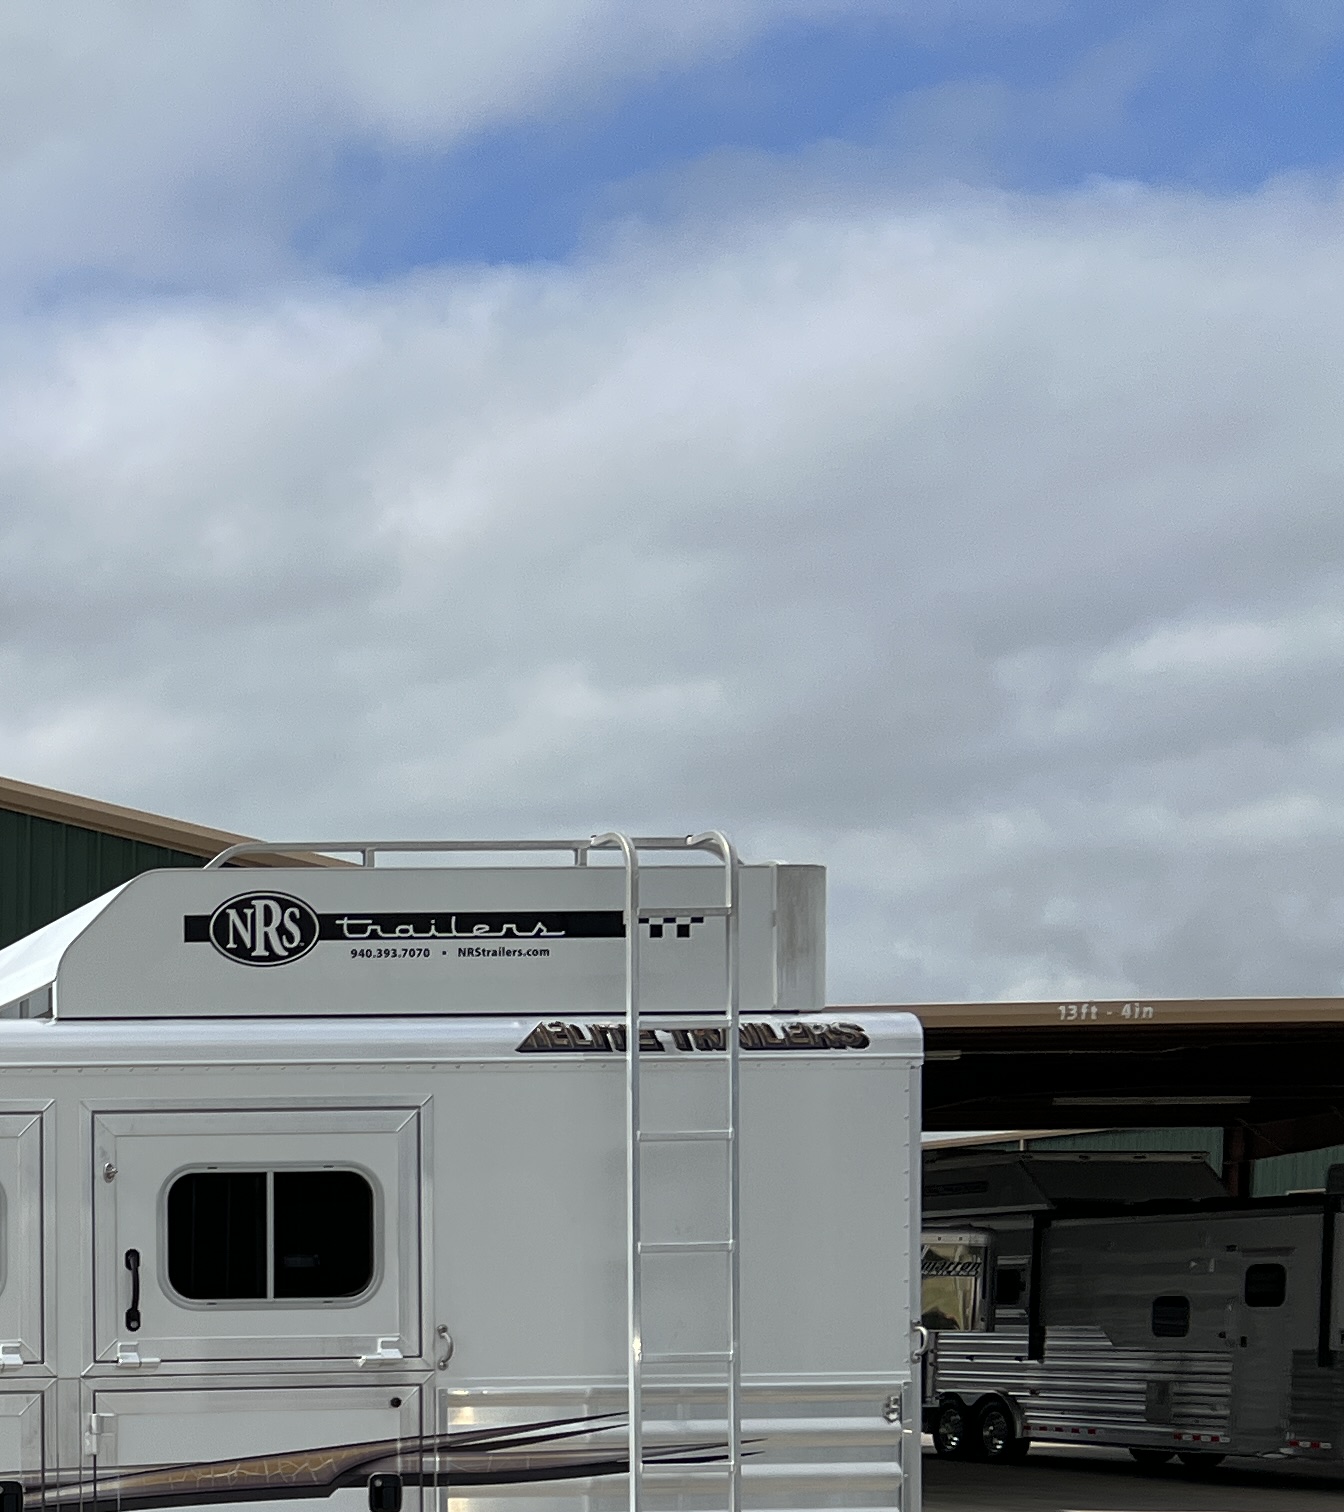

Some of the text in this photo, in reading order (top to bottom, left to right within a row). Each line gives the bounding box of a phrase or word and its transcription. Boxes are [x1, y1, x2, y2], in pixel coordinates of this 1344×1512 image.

[225, 899, 302, 957] NRS
[335, 916, 566, 938] trailers
[350, 947, 550, 959] 940.393.7070 NRStrailers.com
[1057, 1003, 1098, 1021] 13ft
[1121, 1002, 1154, 1019] 4in
